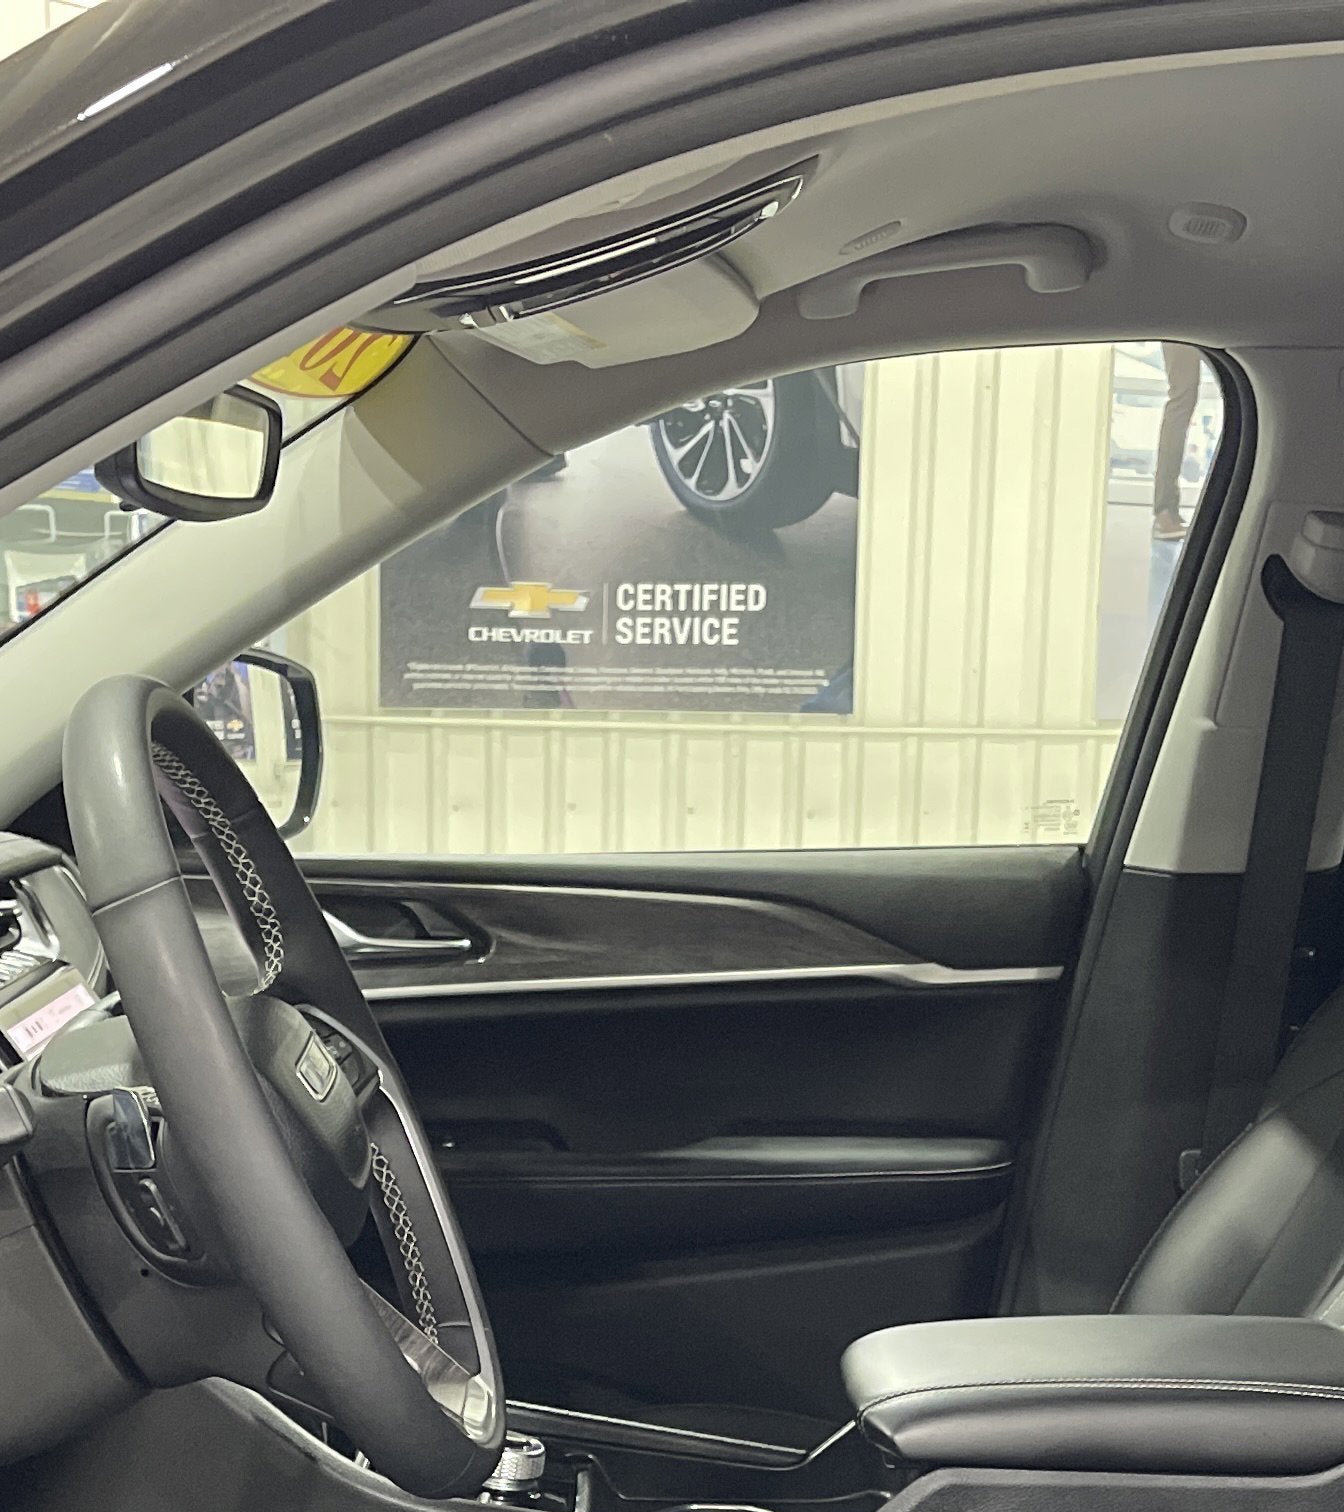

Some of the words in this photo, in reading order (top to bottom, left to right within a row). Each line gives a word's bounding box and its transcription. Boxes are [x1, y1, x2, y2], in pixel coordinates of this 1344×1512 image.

[616, 583, 768, 612] CERTIFIED
[467, 626, 594, 645] CHEVROLET
[615, 617, 740, 646] SERVICE
